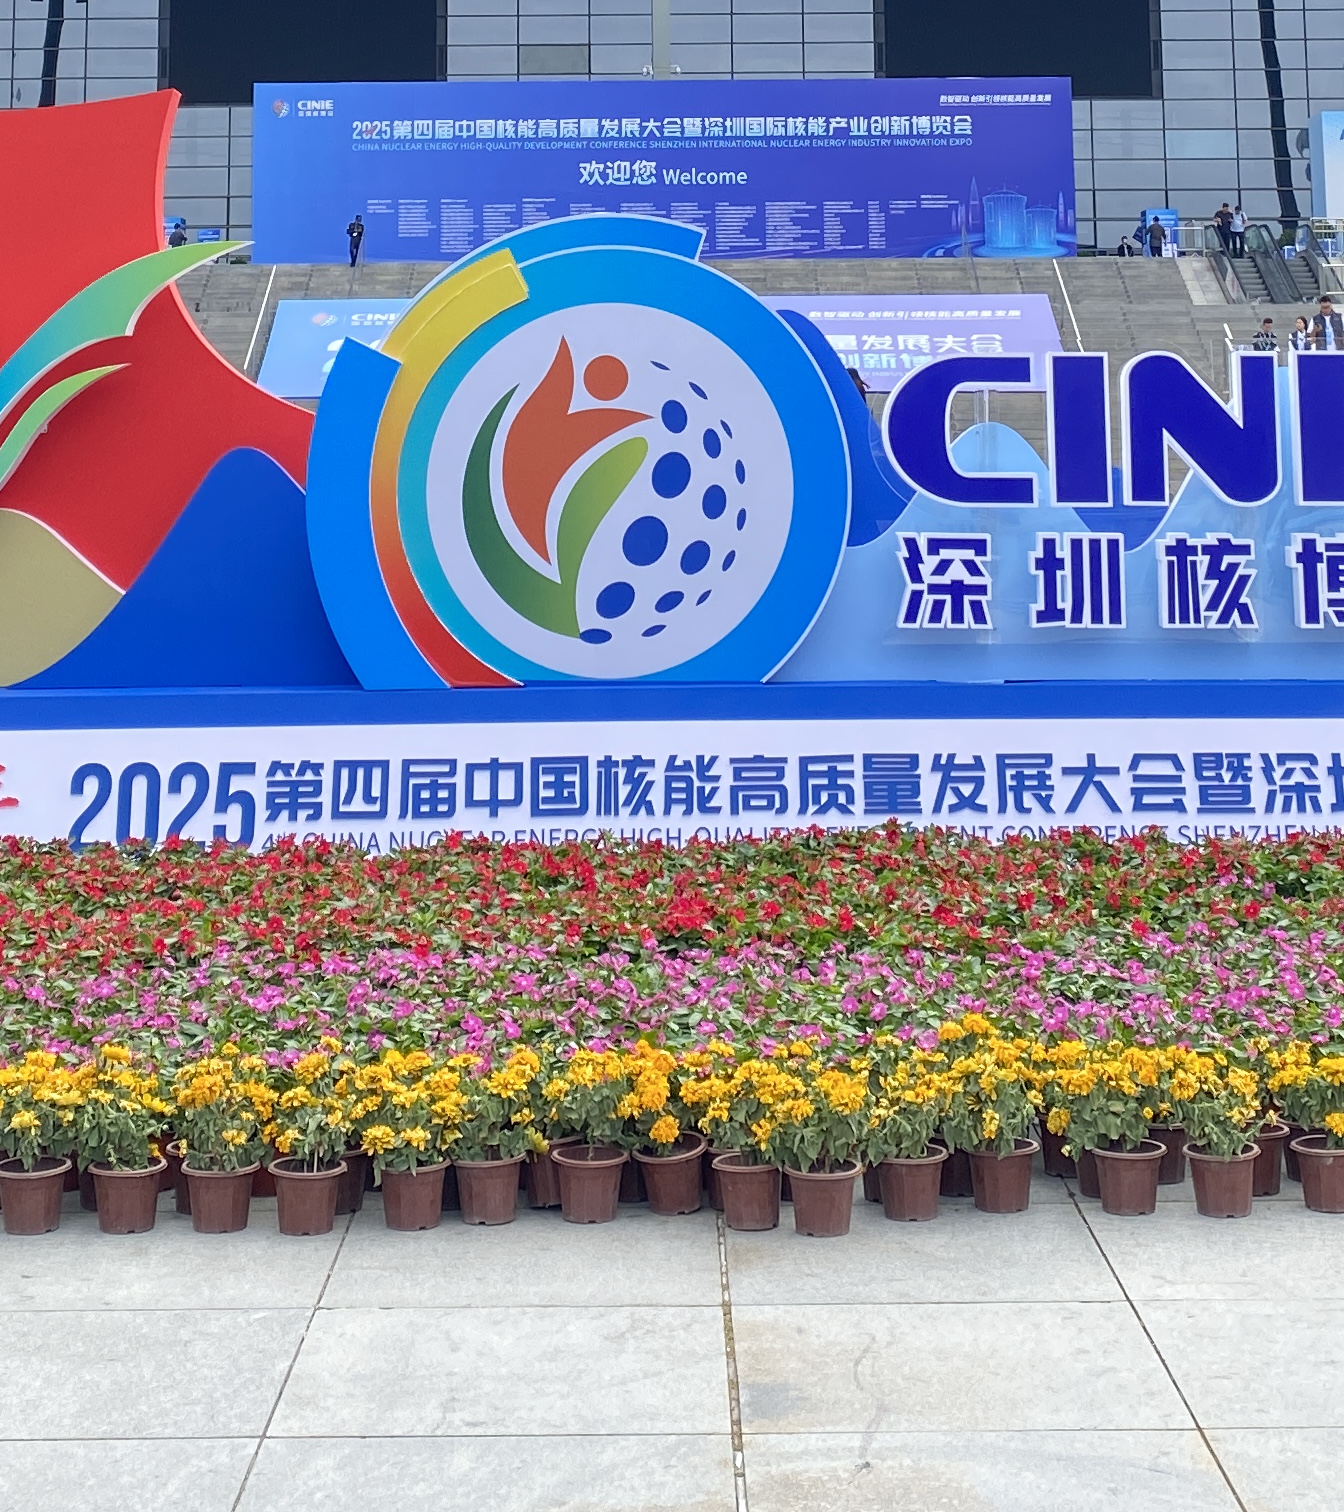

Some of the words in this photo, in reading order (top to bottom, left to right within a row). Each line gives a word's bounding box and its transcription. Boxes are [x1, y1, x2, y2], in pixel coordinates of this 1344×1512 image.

[298, 100, 334, 110] CINIE
[352, 143, 379, 151] CHINA
[382, 142, 422, 150] NUCLEAR
[425, 142, 458, 150] ENERGY
[460, 141, 522, 151] HIGH-QUALITY
[524, 141, 588, 149] DEVELOPMENT
[590, 140, 647, 149] CONFERENCE
[649, 140, 697, 148] SHENZHEN
[699, 139, 768, 148] INTERNATIONAL
[770, 139, 810, 147] NUCLEAR
[813, 138, 846, 147] ENERGY
[848, 138, 891, 147] INDUSTRY
[893, 138, 947, 146] INNOVATION
[949, 138, 973, 146] EXPO
[579, 160, 656, 185] 欢迎您
[663, 167, 748, 185] Welcome
[351, 313, 400, 321] CINI
